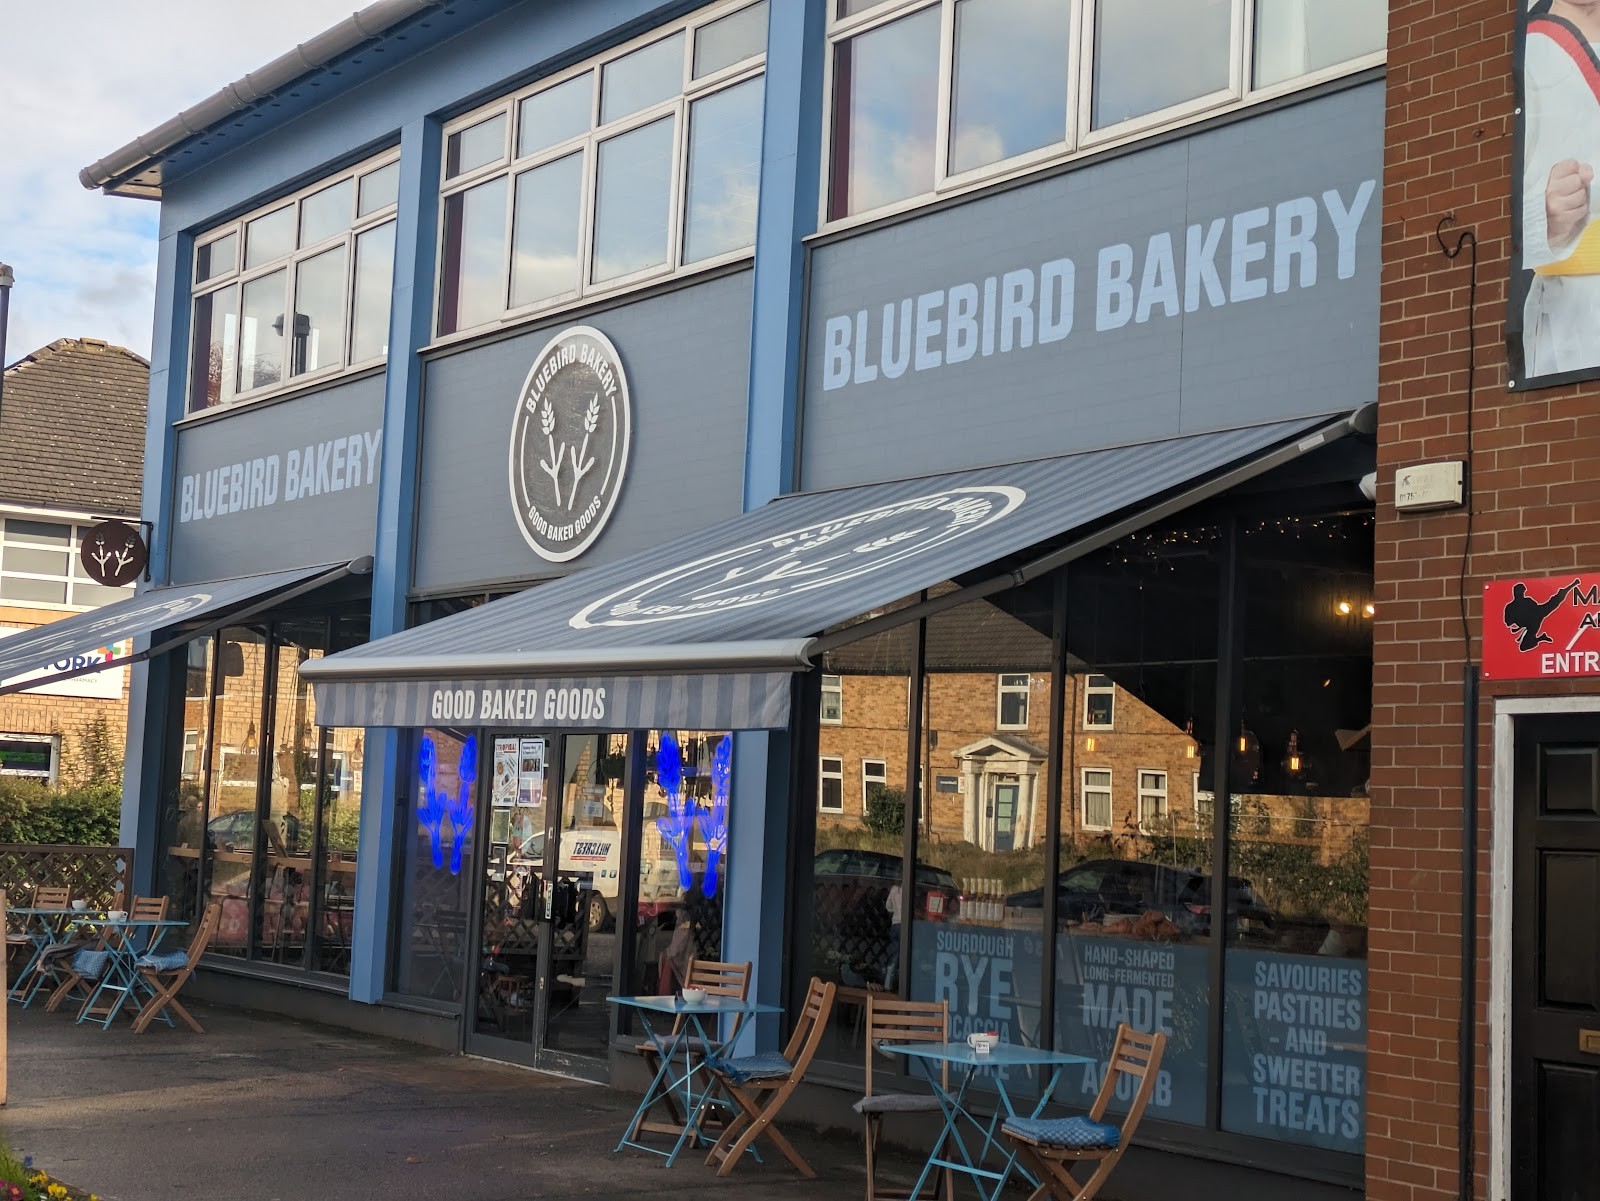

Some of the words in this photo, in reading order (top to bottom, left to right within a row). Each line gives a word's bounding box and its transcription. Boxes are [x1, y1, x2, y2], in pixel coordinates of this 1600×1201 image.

[822, 257, 1076, 391] BLUEBIRD
[1094, 179, 1376, 332] BAKERY
[526, 343, 577, 414] BLUEBIRD
[579, 343, 617, 397] BAKERY
[179, 454, 280, 523] BLUEBIRD
[284, 428, 382, 502] BAKERY
[528, 506, 547, 536] GOOD
[547, 524, 574, 542] BAKED
[574, 495, 601, 535] GOODS
[431, 689, 475, 720] GOOD
[479, 689, 537, 720] BAKED
[543, 687, 607, 720] GOODS
[936, 930, 1014, 958] SOURDOUGH
[1084, 944, 1175, 971] HAND-SHAPED
[935, 951, 1013, 1020] RYE
[1083, 966, 1175, 988] LONG-FERMENTED
[1255, 960, 1362, 997] SAVOURIES
[1082, 983, 1174, 1038] MADE
[1254, 990, 1361, 1031] PASTRIES
[1285, 1028, 1327, 1056] AND
[1253, 1055, 1361, 1097] SWEETER
[1252, 1086, 1360, 1140] TREATS
